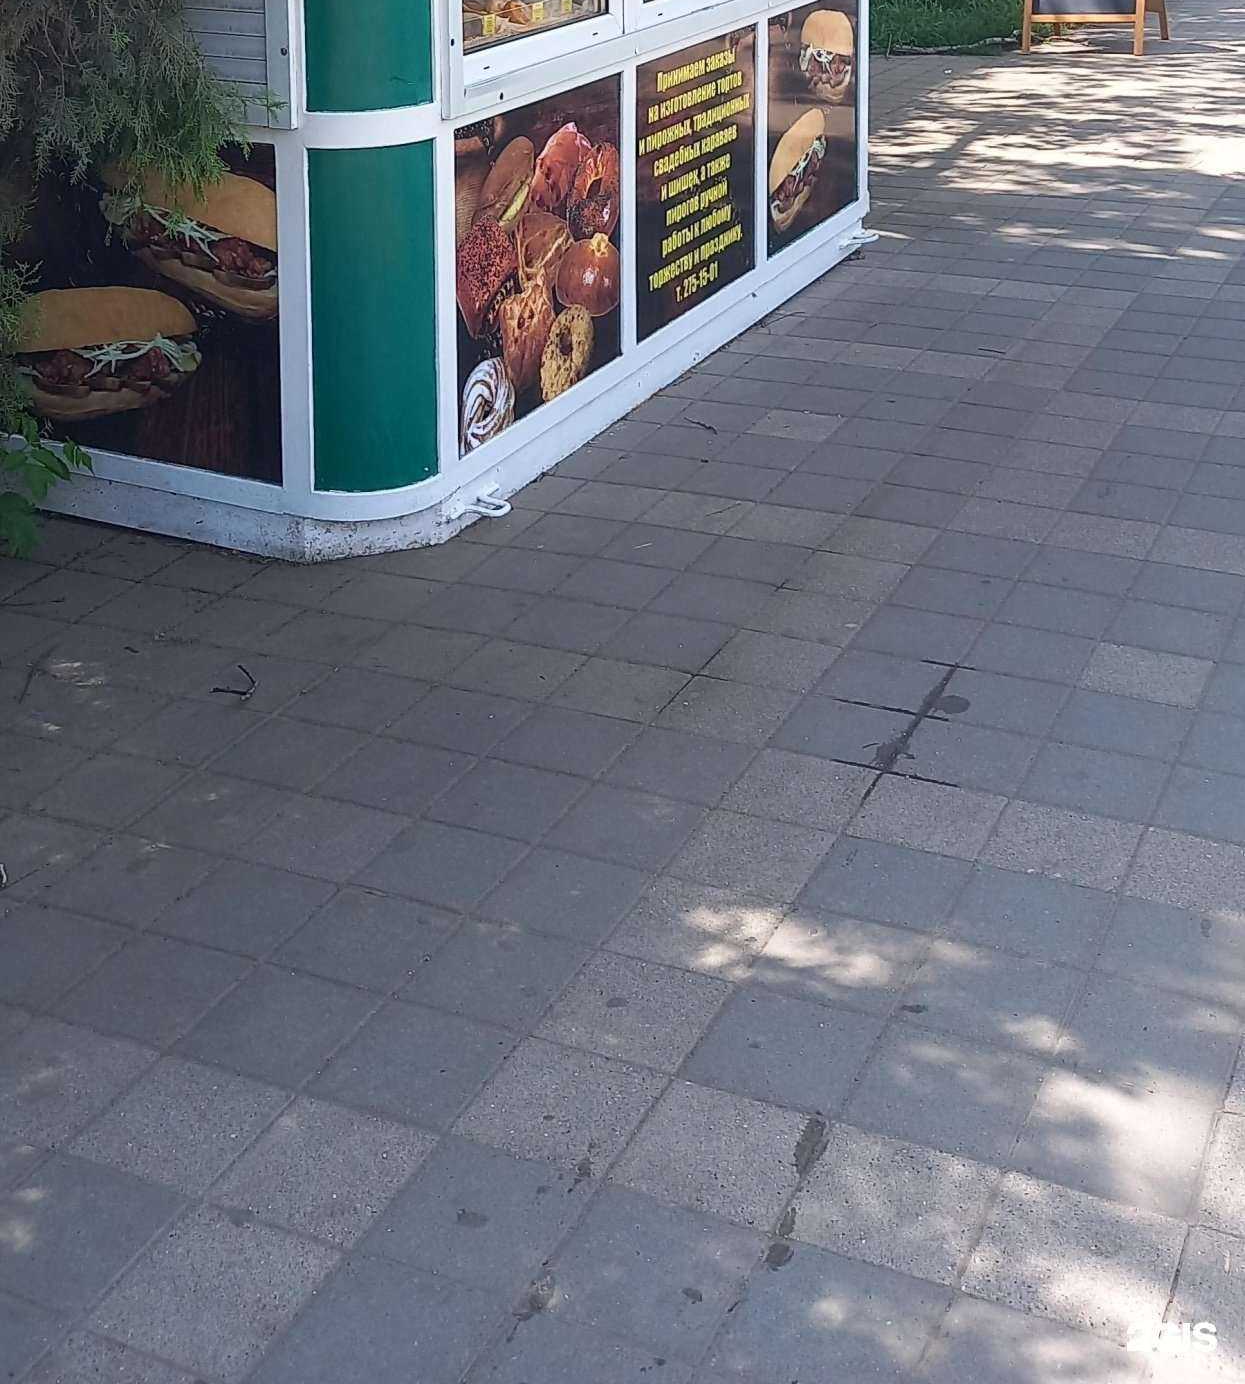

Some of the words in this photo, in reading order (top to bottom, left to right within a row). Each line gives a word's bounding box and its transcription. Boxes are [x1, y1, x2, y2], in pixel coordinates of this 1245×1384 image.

[656, 59, 706, 93] Принимаем
[706, 47, 736, 73] заказы
[648, 104, 659, 124] на
[660, 82, 717, 119] изготовление
[717, 71, 743, 95] тортов
[639, 138, 646, 156] и
[693, 93, 750, 132] традиционных
[654, 141, 701, 177] свадебных
[701, 124, 738, 154] караваев
[661, 184, 668, 202] и
[707, 153, 731, 178] также
[666, 195, 699, 227] пирогов
[700, 178, 728, 210] ручной
[662, 224, 694, 258] работы
[700, 204, 732, 235] любому
[649, 251, 693, 292] торжеству
[683, 261, 718, 299] 275-15-01
